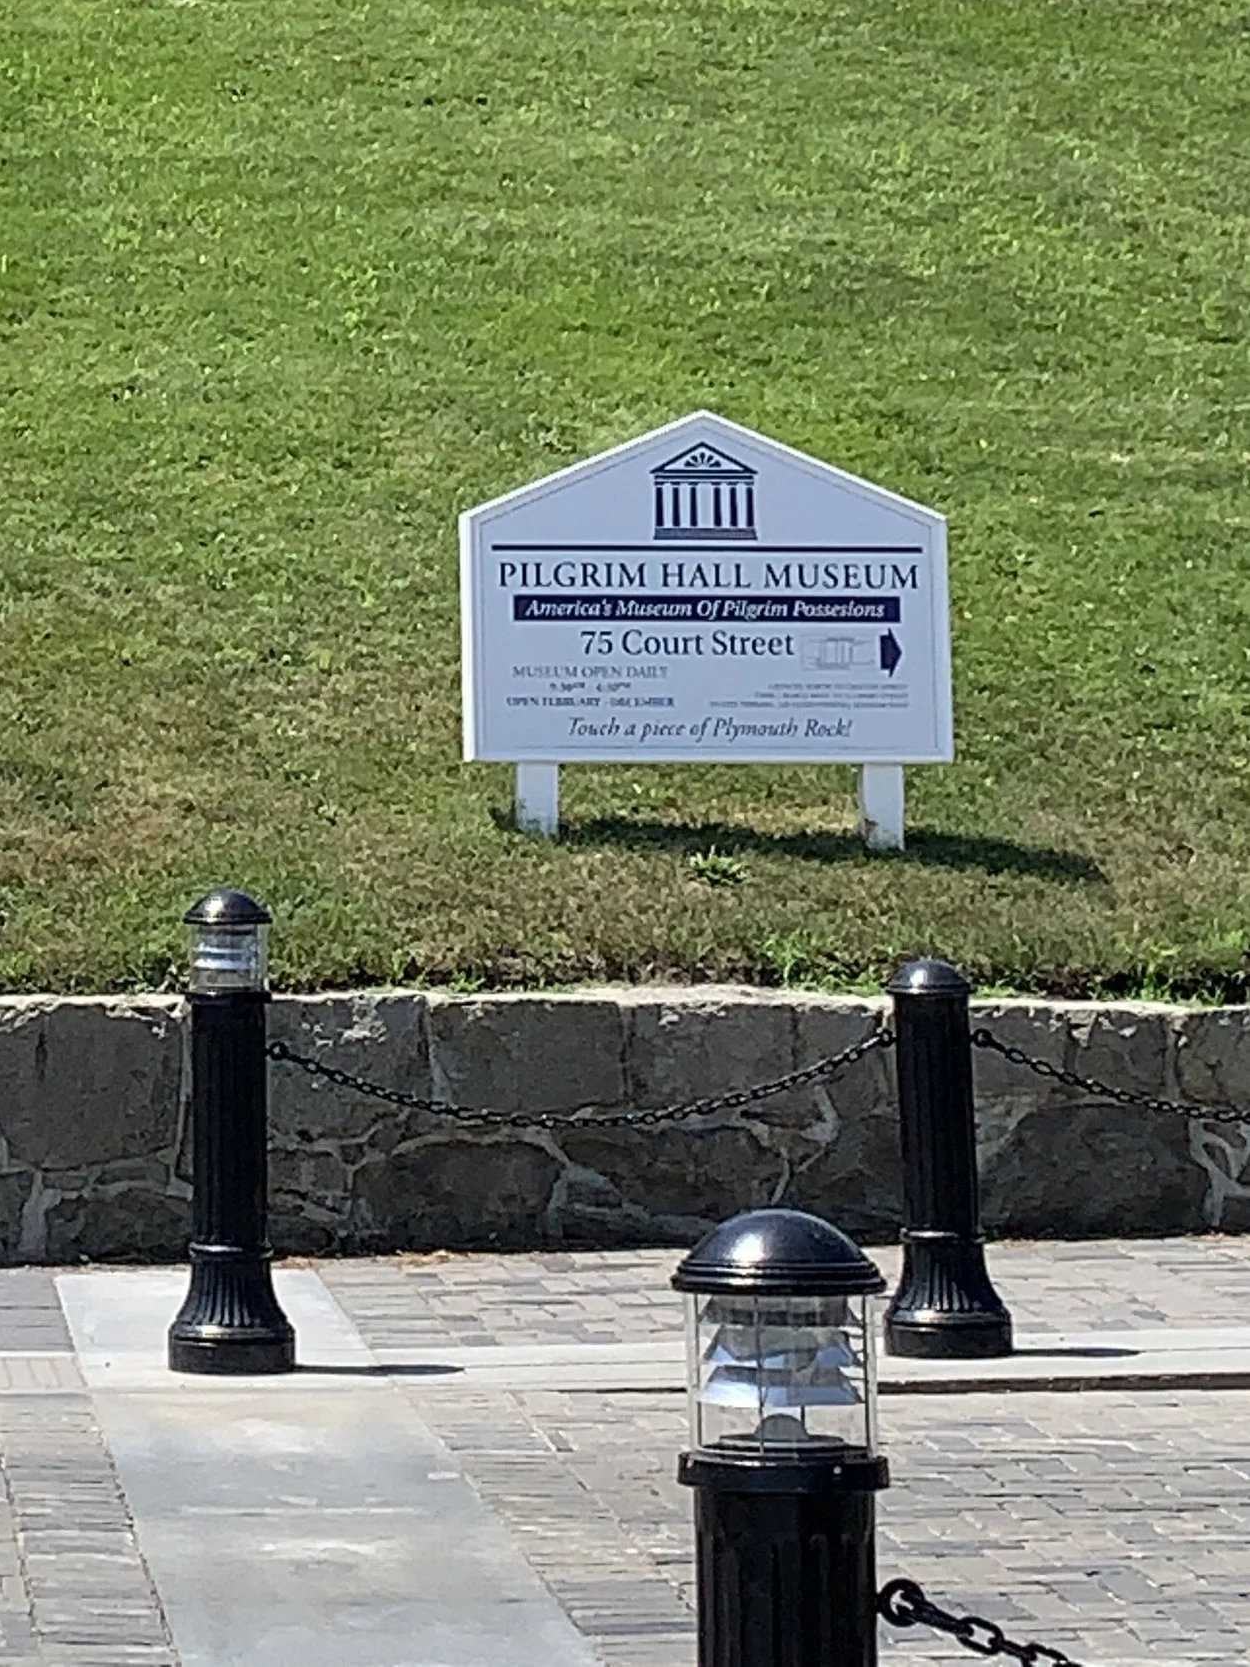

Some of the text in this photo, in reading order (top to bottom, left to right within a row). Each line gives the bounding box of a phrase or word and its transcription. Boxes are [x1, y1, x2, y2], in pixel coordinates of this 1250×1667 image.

[499, 562, 919, 589] PILGRIM HALL MUSEUM
[525, 598, 612, 617] America's
[615, 600, 692, 617] Museum
[697, 600, 721, 620] Of
[722, 599, 788, 621] Pilgrim
[580, 630, 794, 655] 75 Court Street
[512, 666, 668, 679] MUSEUM OPEN DAILY
[568, 716, 853, 742] Touch a piece of Plymouth Rock!
